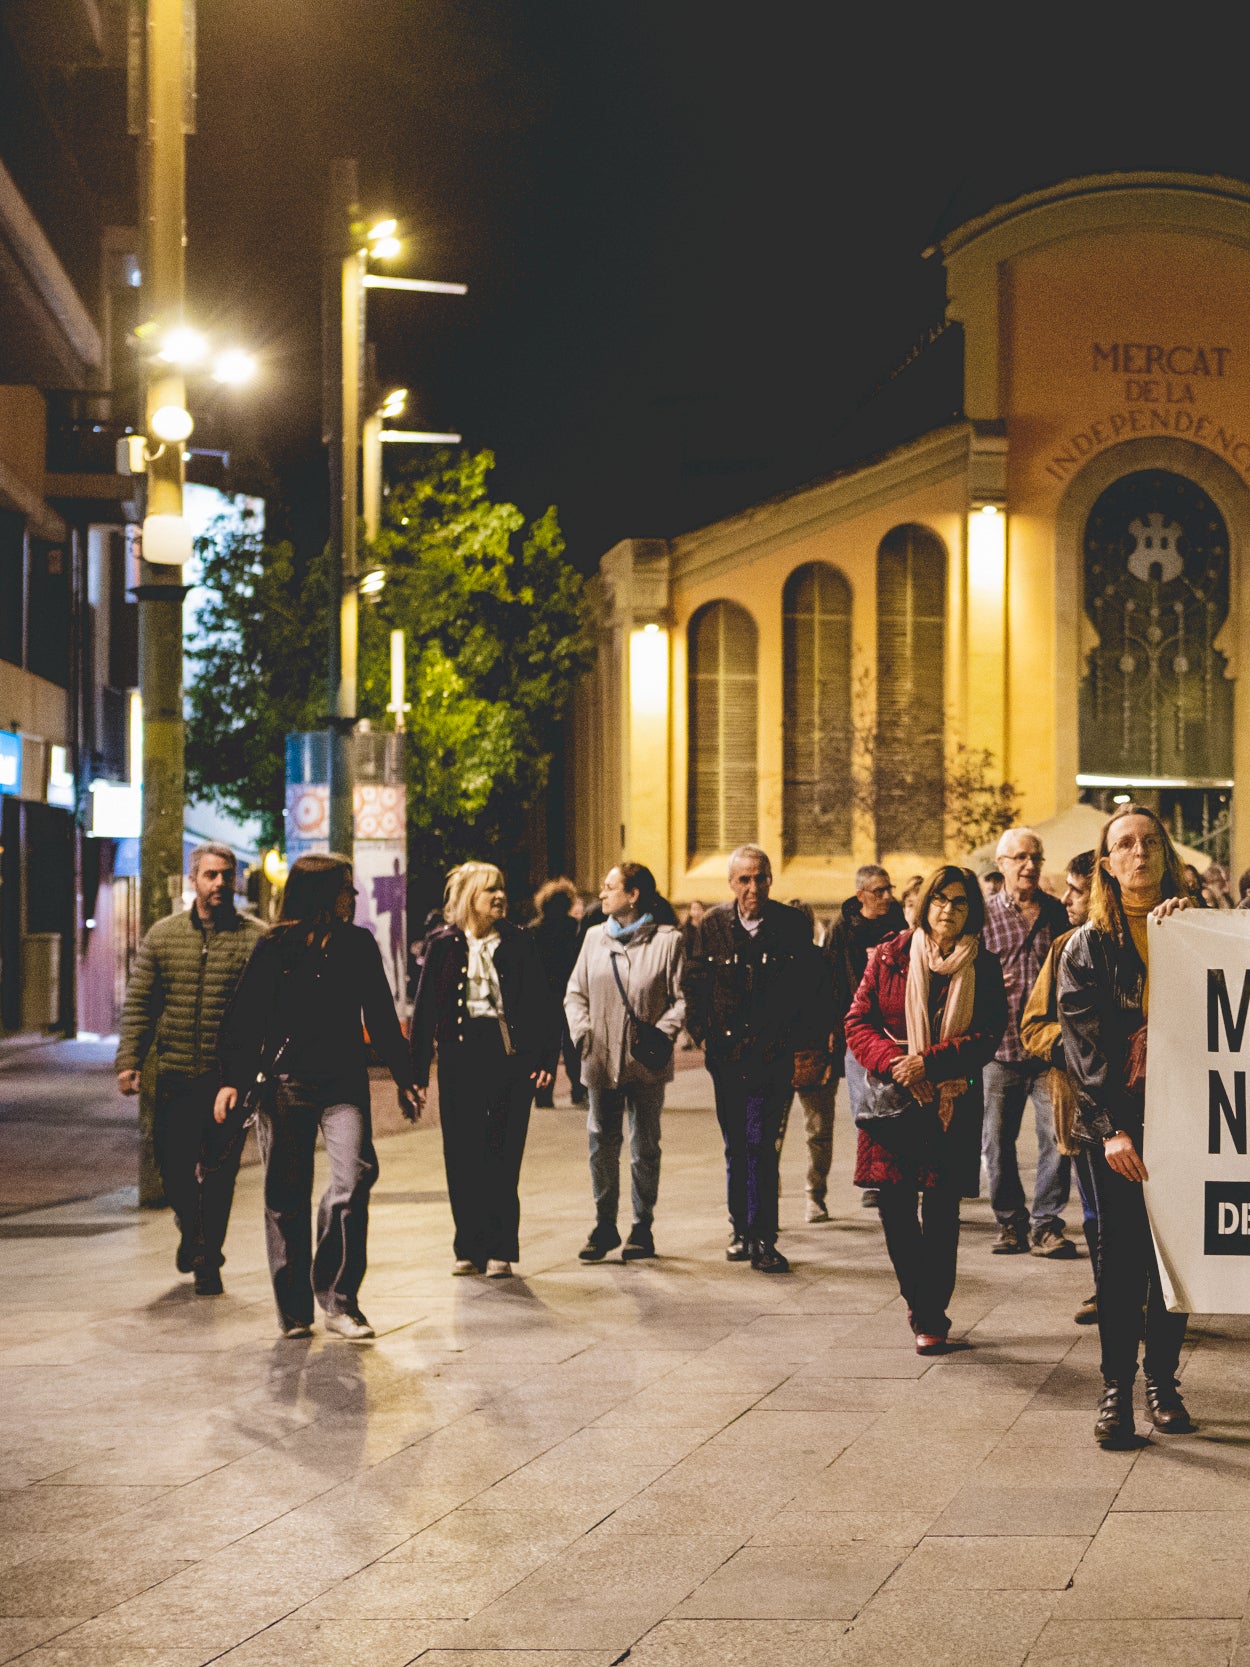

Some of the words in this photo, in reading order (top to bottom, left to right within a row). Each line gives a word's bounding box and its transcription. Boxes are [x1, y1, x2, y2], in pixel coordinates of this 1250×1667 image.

[1092, 342, 1231, 377] MERCAT
[1124, 379, 1159, 402] DE
[1166, 382, 1195, 404] LA
